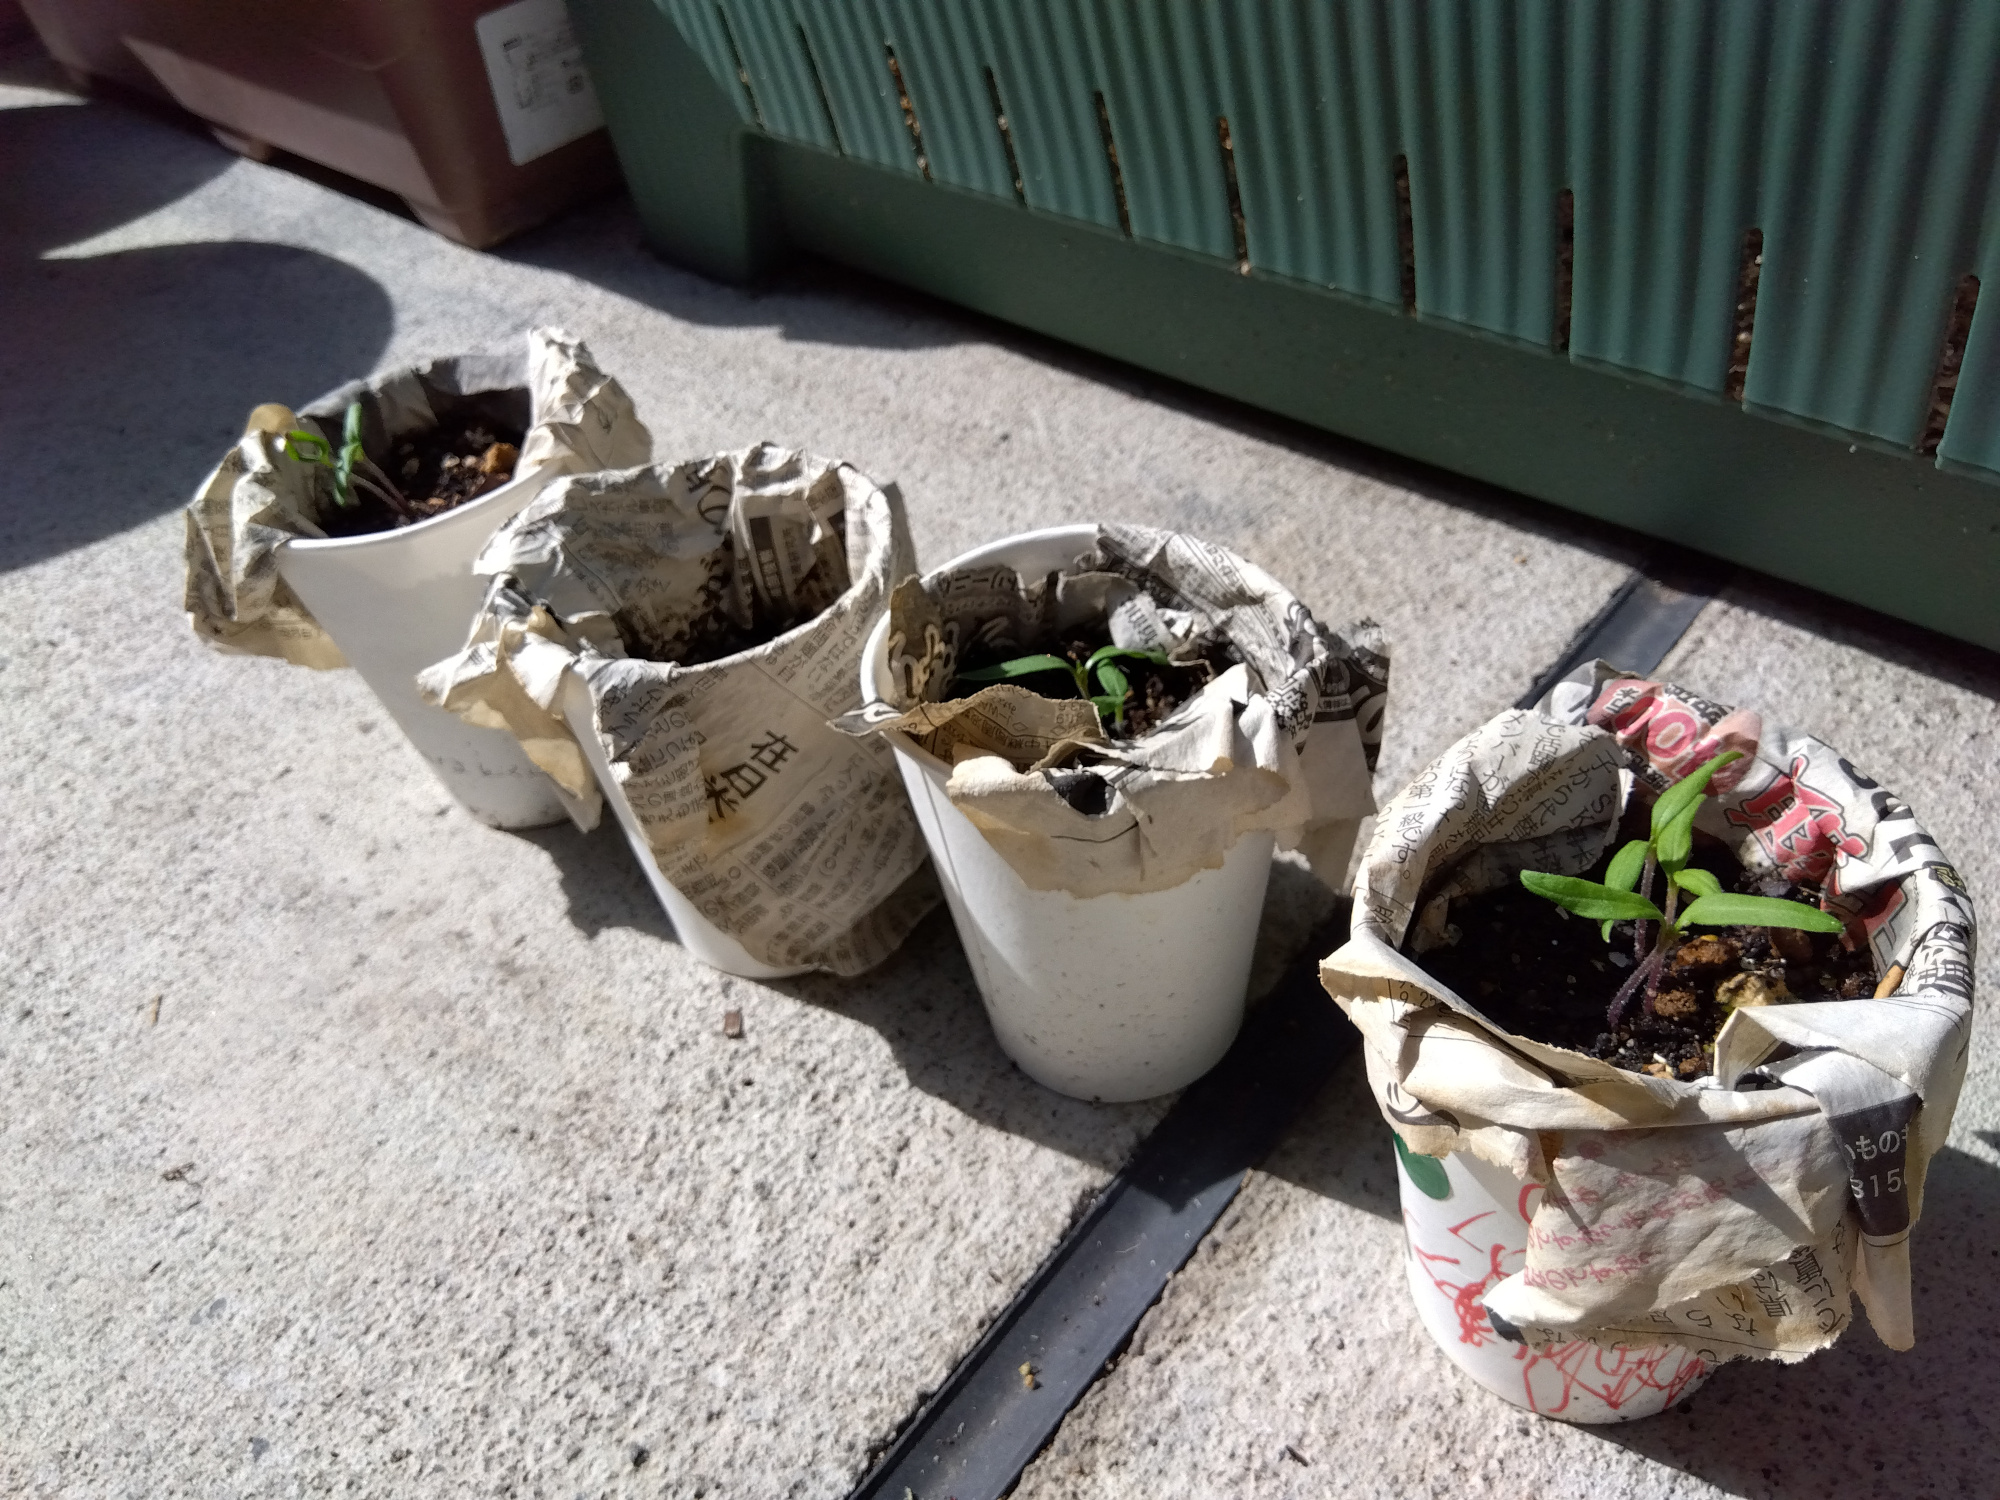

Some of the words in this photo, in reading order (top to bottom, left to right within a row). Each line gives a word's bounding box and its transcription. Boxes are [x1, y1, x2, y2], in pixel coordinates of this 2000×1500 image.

[704, 729, 799, 824] 在日米
[1850, 1168, 1905, 1199] 315
